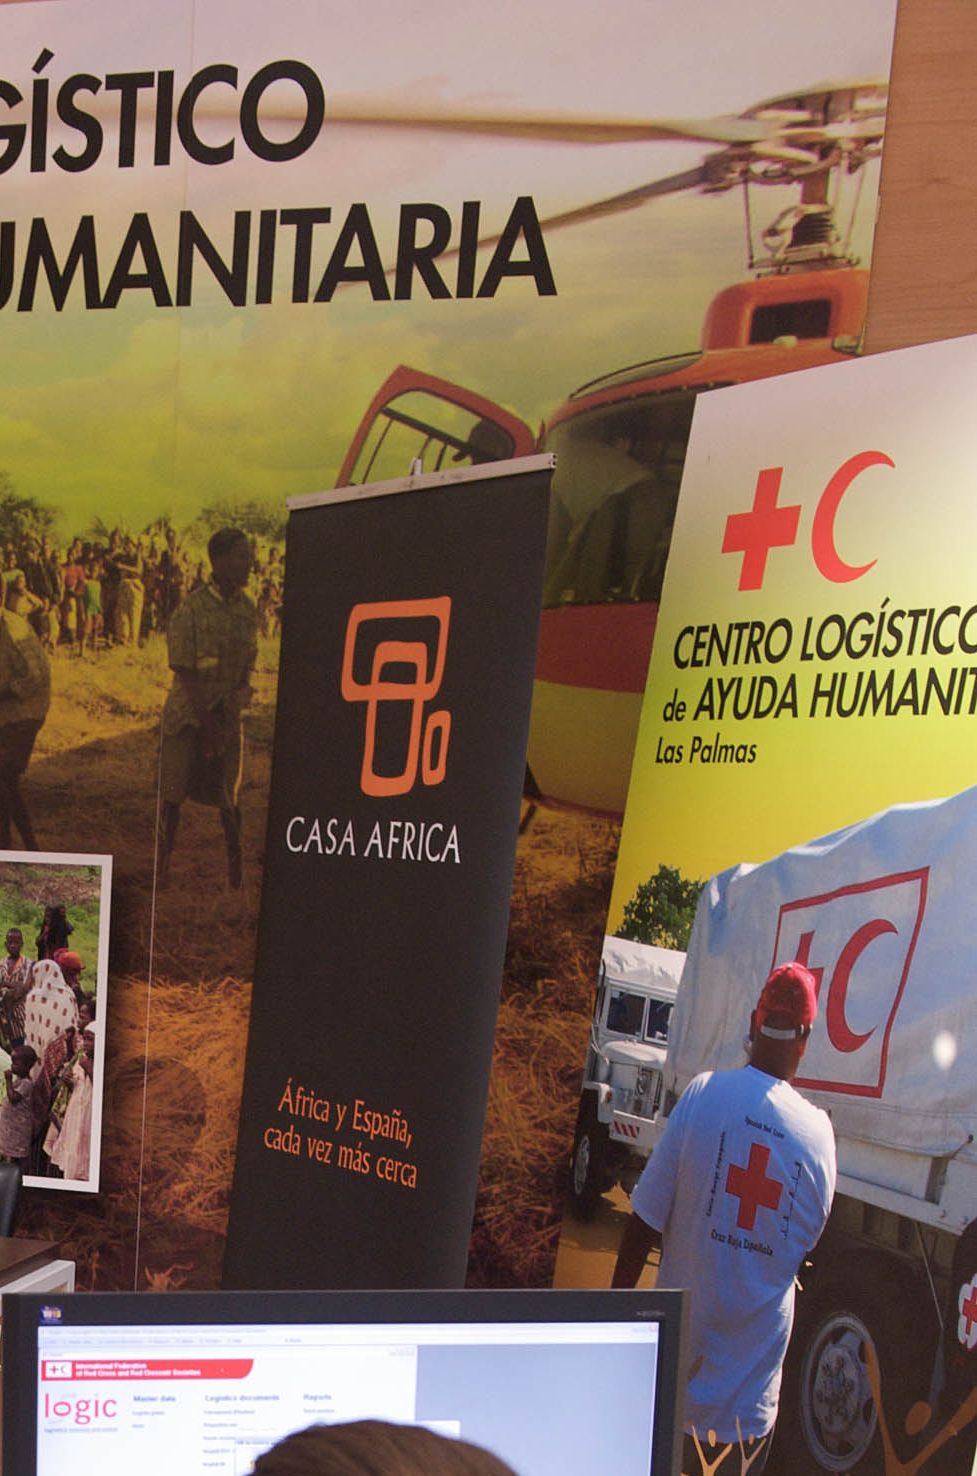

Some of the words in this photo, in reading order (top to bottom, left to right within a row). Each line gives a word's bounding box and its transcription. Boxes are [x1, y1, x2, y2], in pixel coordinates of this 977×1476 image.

[674, 618, 793, 669] CENTRO
[800, 596, 977, 662] LOGÍSTICO
[663, 687, 687, 722] de
[693, 673, 798, 721] AYUDA
[655, 736, 683, 764] Las
[689, 732, 757, 764] Palmas
[286, 816, 356, 856] CASA
[364, 820, 462, 864] AFRICA
[278, 1077, 330, 1123] África
[336, 1102, 347, 1132] y
[353, 1099, 413, 1149] España,
[264, 1124, 301, 1155] cada
[308, 1138, 333, 1164] vez
[338, 1142, 370, 1175] más
[376, 1155, 418, 1189] cerca
[44, 1393, 117, 1425] logic
